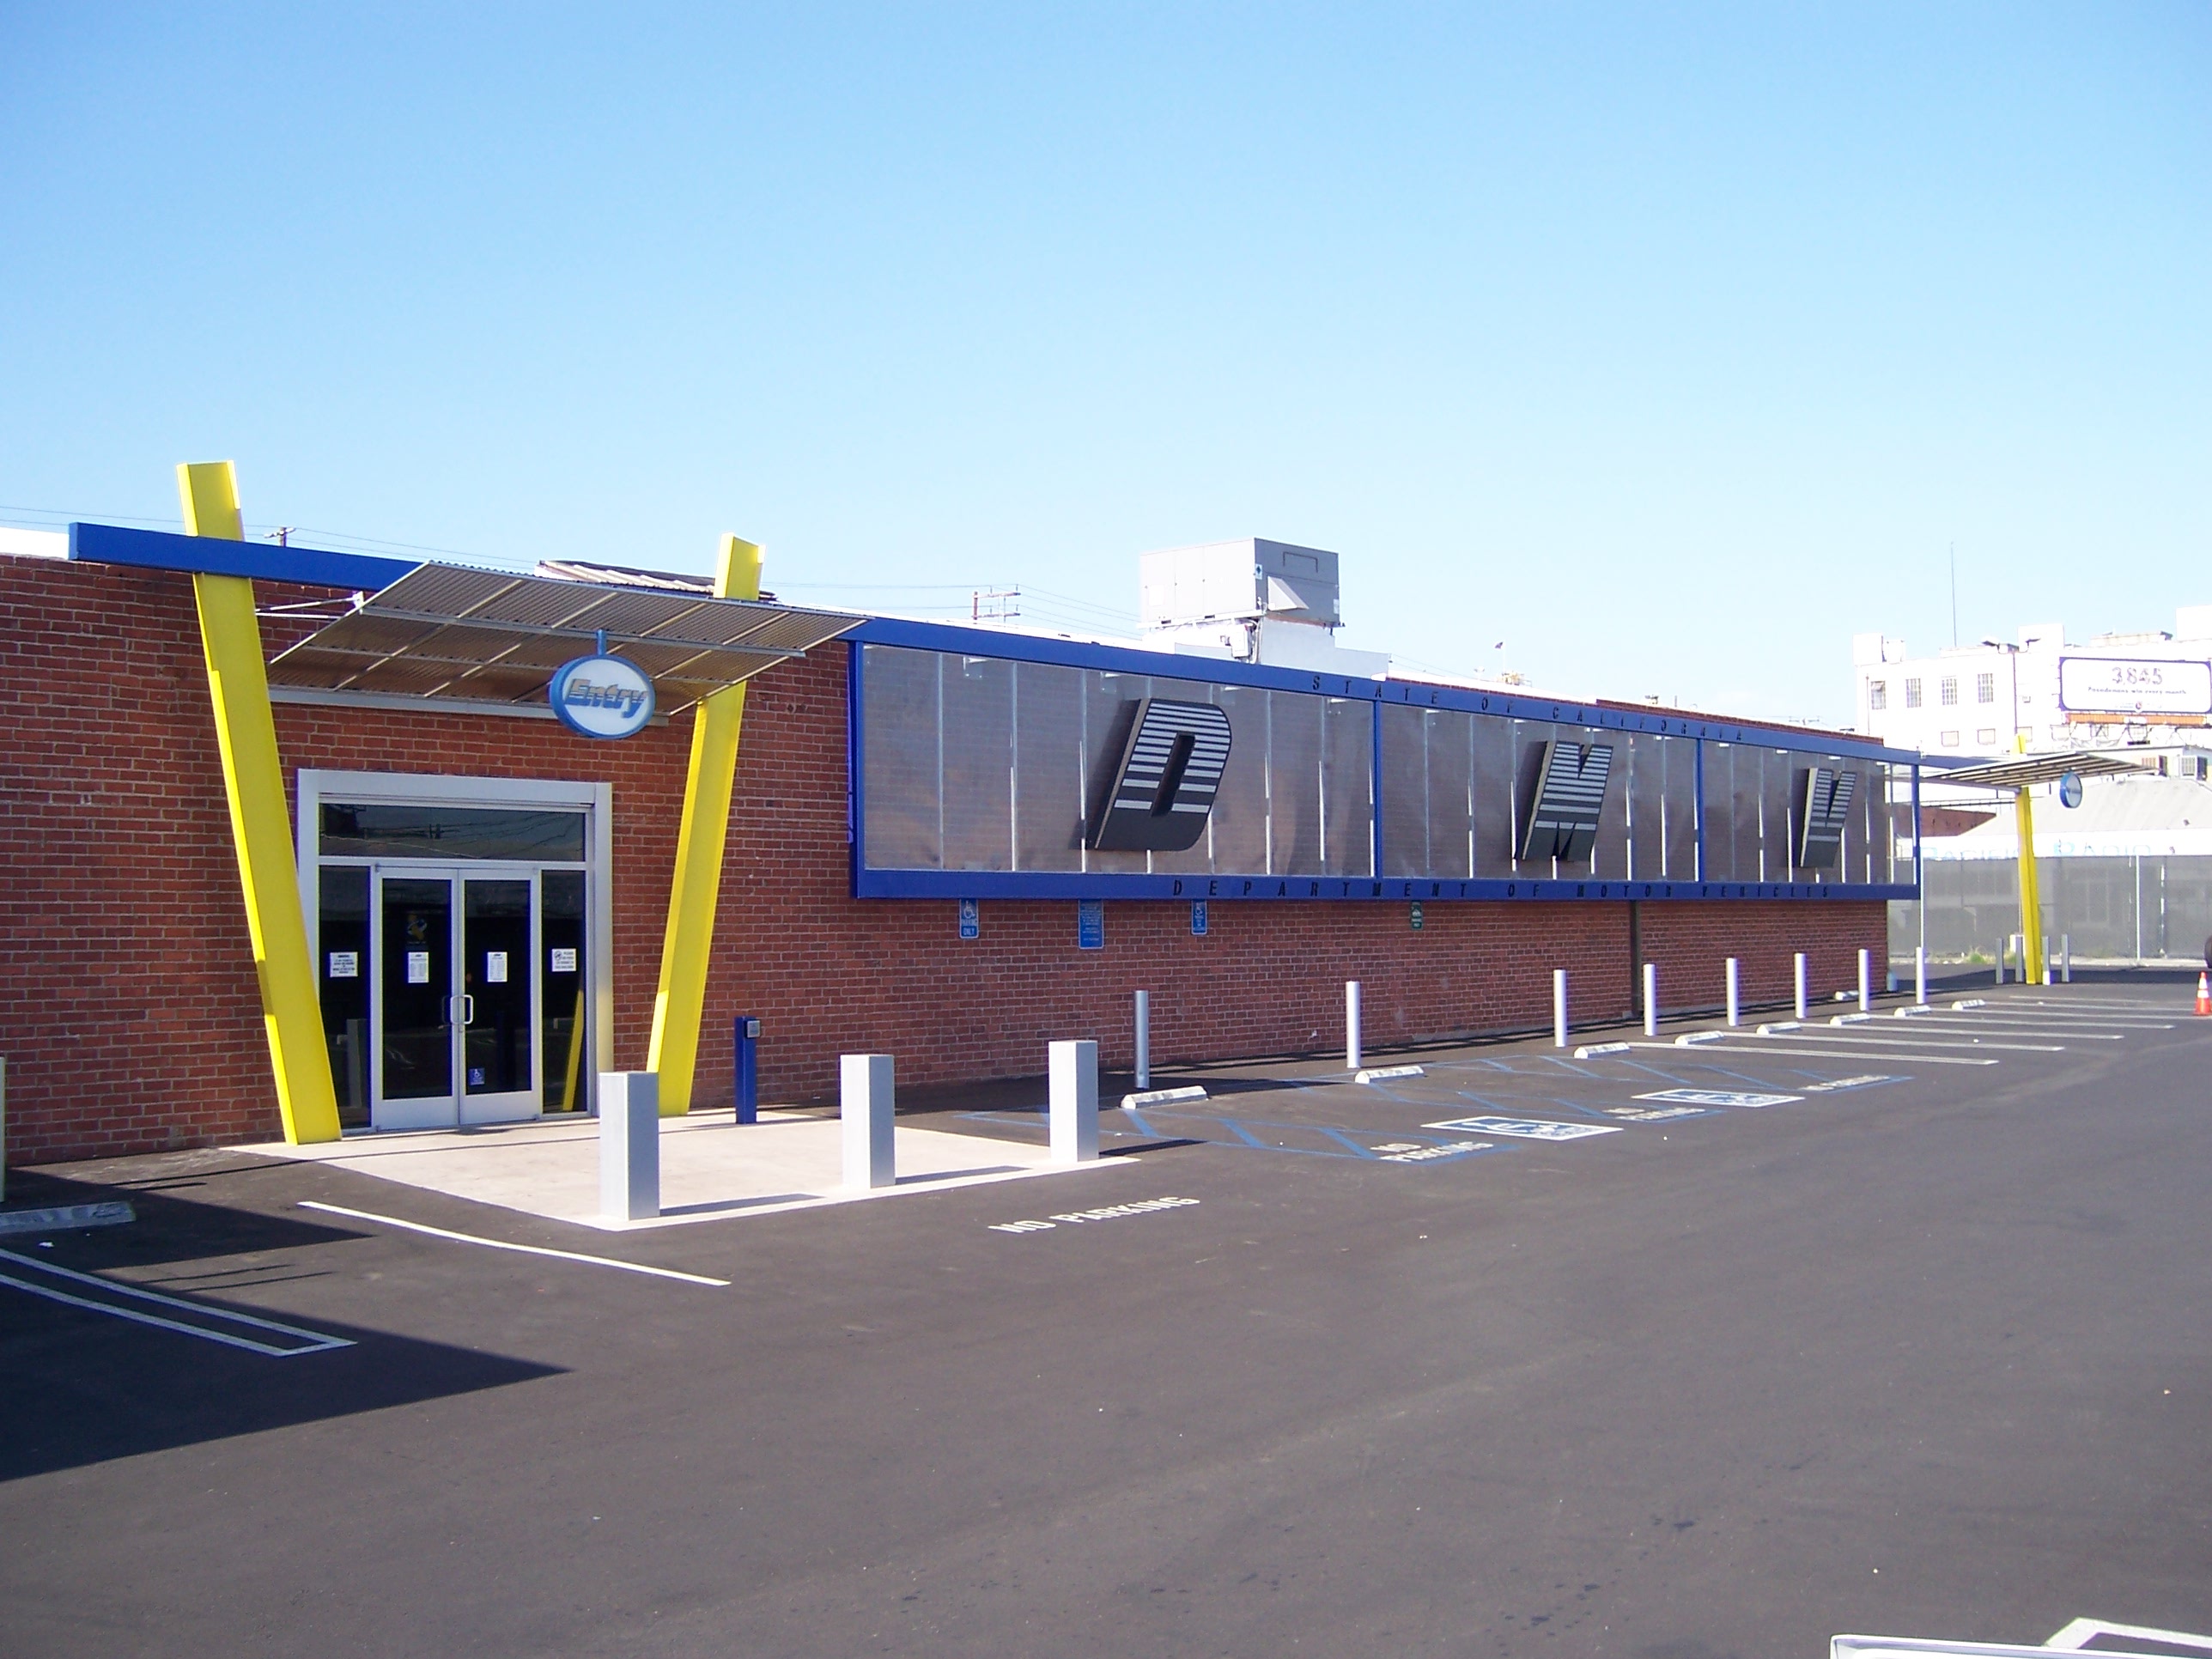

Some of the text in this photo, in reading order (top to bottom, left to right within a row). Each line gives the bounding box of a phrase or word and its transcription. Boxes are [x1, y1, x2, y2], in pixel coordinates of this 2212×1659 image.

[564, 678, 649, 719] Entry
[1311, 675, 1742, 741] STATE OF CALIFORNIA
[1173, 879, 1829, 898] DEPARTMENT OF MOTOR VEHICLES
[988, 1196, 1200, 1233] NO PARKING
